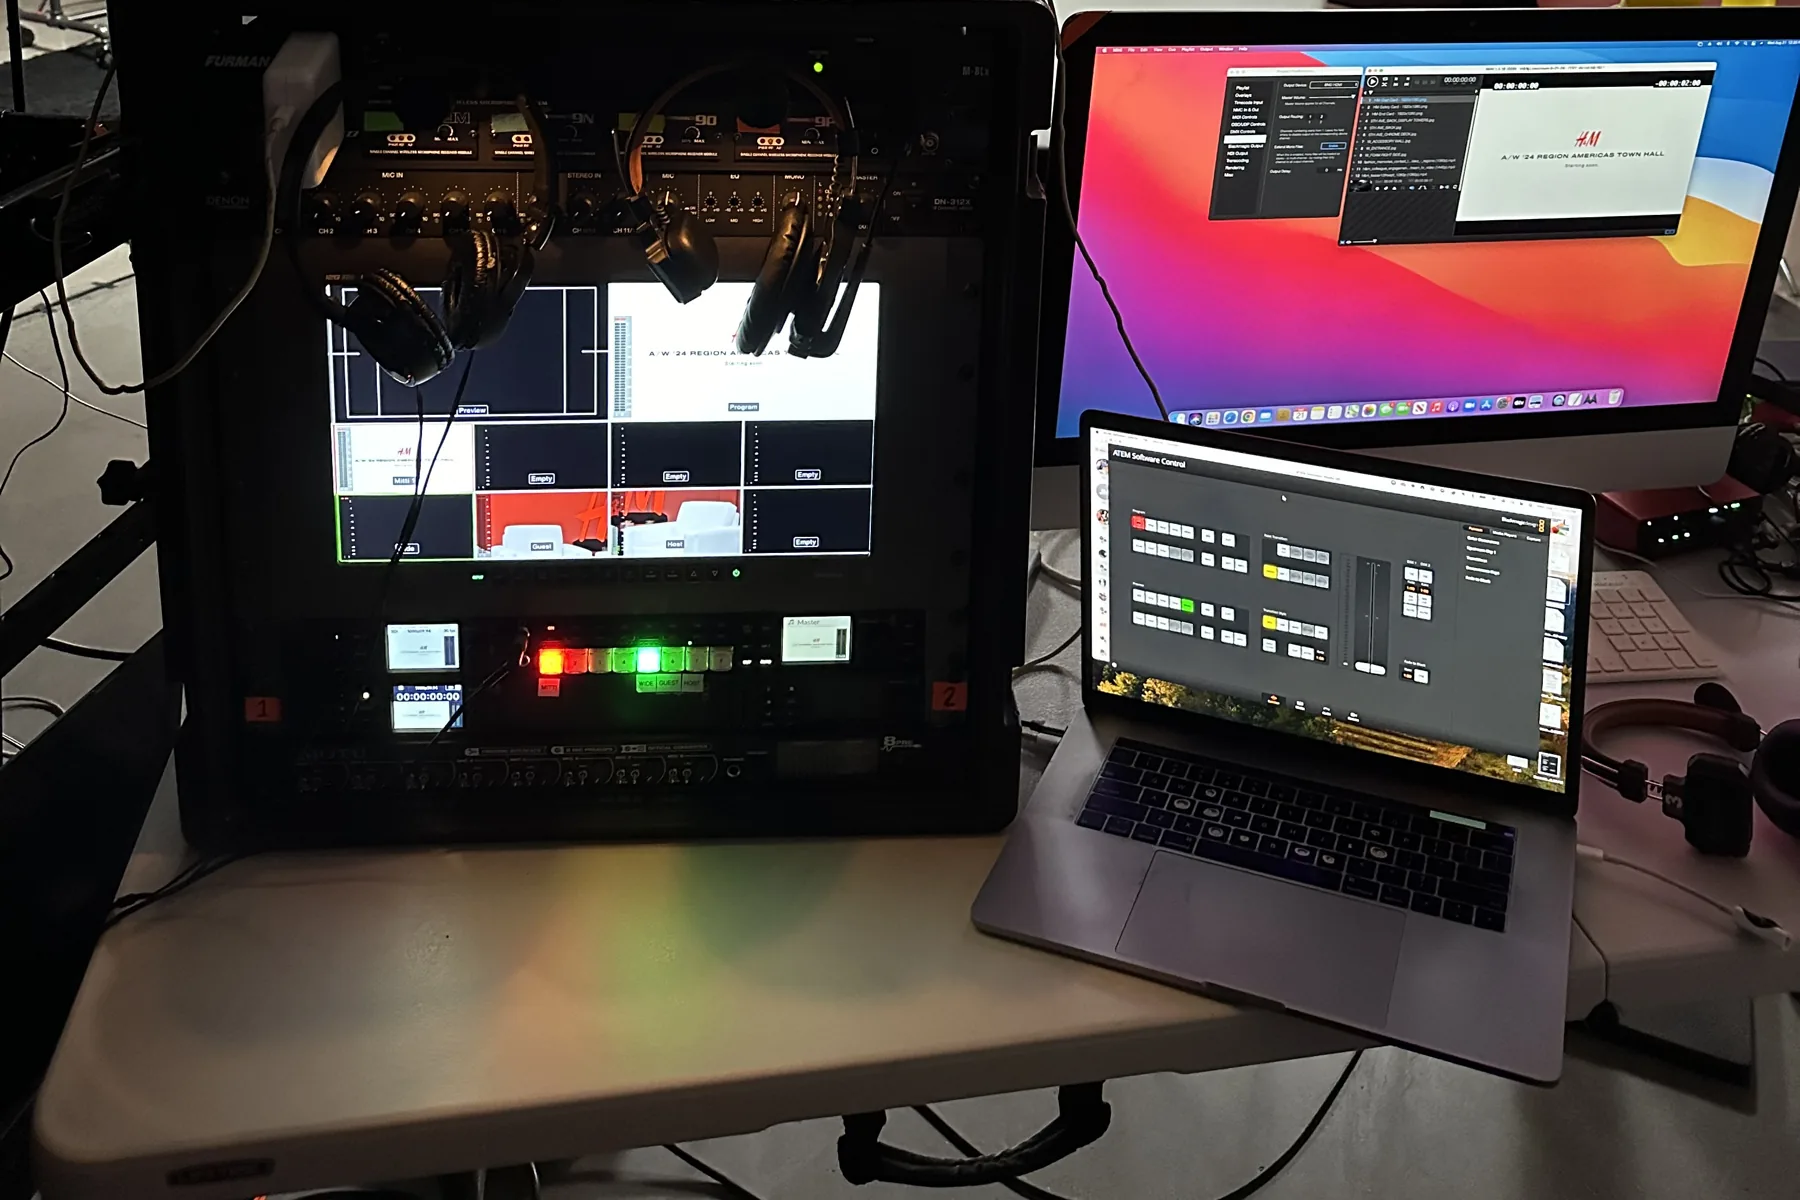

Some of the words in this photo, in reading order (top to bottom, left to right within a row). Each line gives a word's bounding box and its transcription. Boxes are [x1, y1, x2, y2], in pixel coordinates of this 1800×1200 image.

[205, 54, 269, 68] FURMAN
[1494, 82, 1539, 90] 00:00:00:00
[1655, 79, 1701, 87] -00:00:02:00
[1575, 131, 1601, 147] H&M
[205, 196, 249, 206] DENON
[458, 407, 487, 415] Preview
[729, 403, 758, 412] Program
[1113, 450, 1131, 459] ATEM
[1132, 452, 1160, 464] Software
[1161, 458, 1186, 468] Control
[530, 474, 553, 483] Empty
[665, 472, 687, 482] Empty
[797, 471, 819, 480] Empty
[394, 477, 411, 485] Mitti
[667, 540, 683, 548] Host
[796, 538, 817, 547] Empty
[659, 679, 679, 687] GUEST
[396, 692, 460, 701] 00:00:00:00
[942, 686, 956, 707] 2
[256, 700, 269, 718] 1
[1664, 793, 1684, 809] 3
